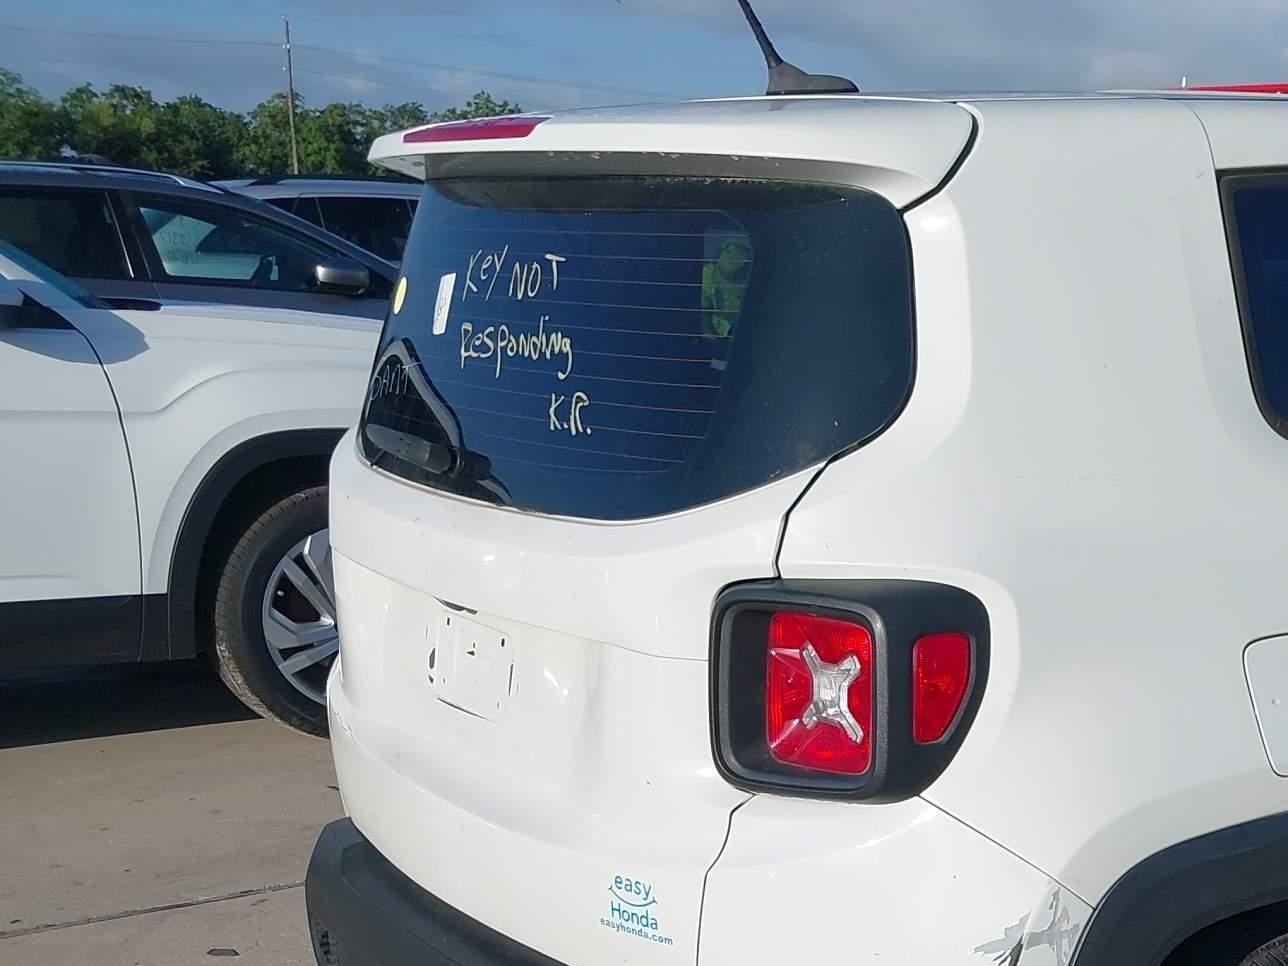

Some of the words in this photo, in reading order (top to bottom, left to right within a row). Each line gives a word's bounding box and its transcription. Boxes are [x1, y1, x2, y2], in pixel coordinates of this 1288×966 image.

[508, 253, 567, 300] NOT
[614, 875, 652, 901] easy
[610, 900, 658, 930] Honda
[599, 918, 674, 946] easyhonda.com
